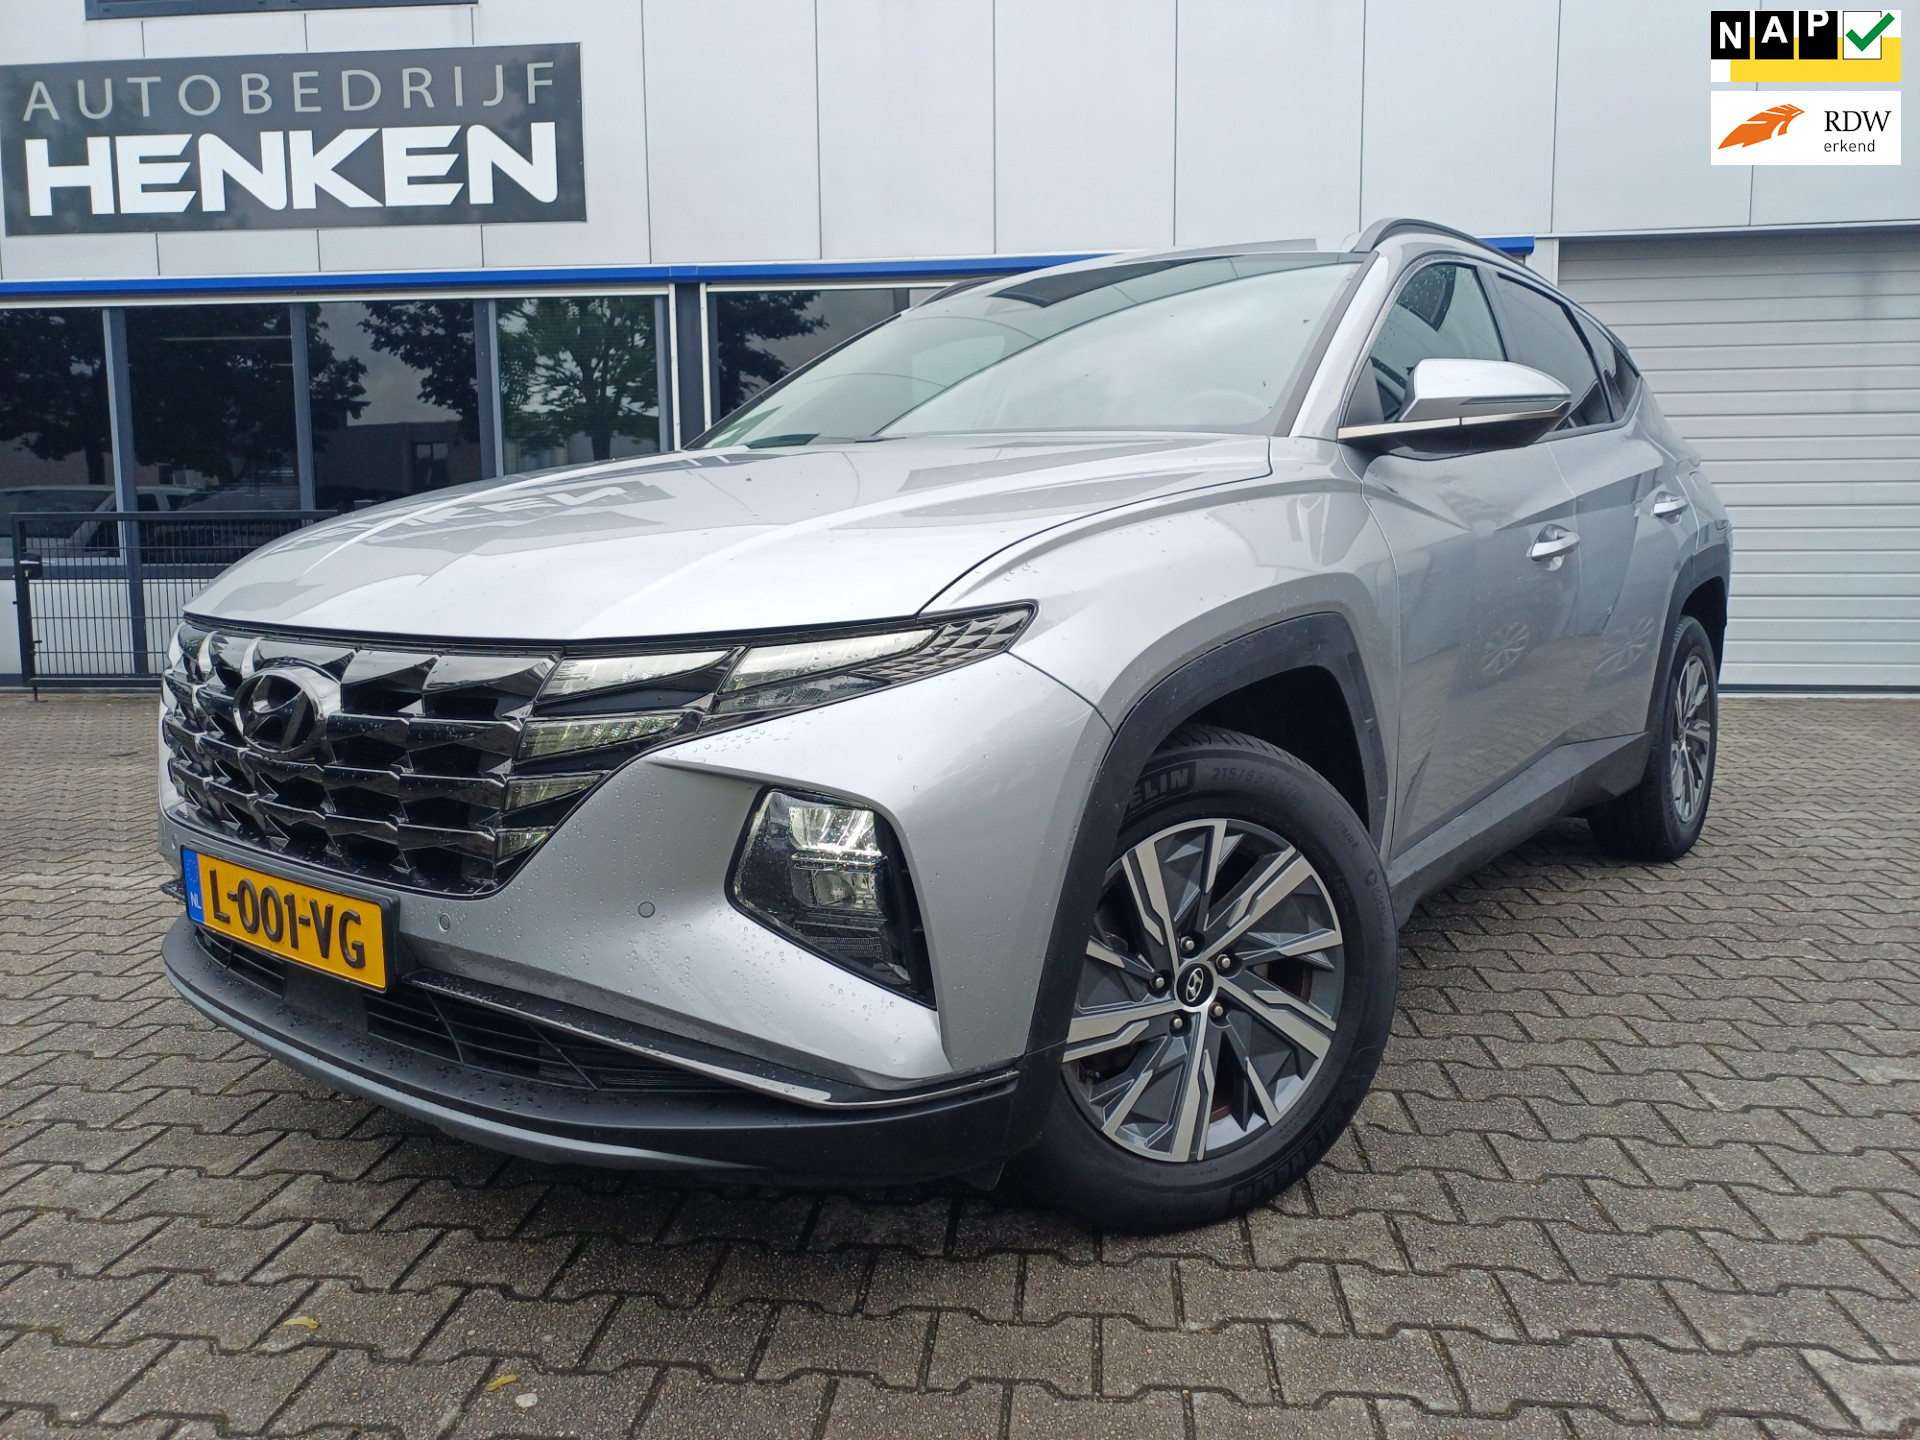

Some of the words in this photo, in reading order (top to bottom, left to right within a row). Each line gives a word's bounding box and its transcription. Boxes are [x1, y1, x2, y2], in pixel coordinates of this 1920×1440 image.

[23, 61, 555, 122] AUTOBEDRIJF
[25, 121, 558, 217] HENKEN
[189, 891, 202, 909] NL
[209, 868, 366, 969] L-001-VG
